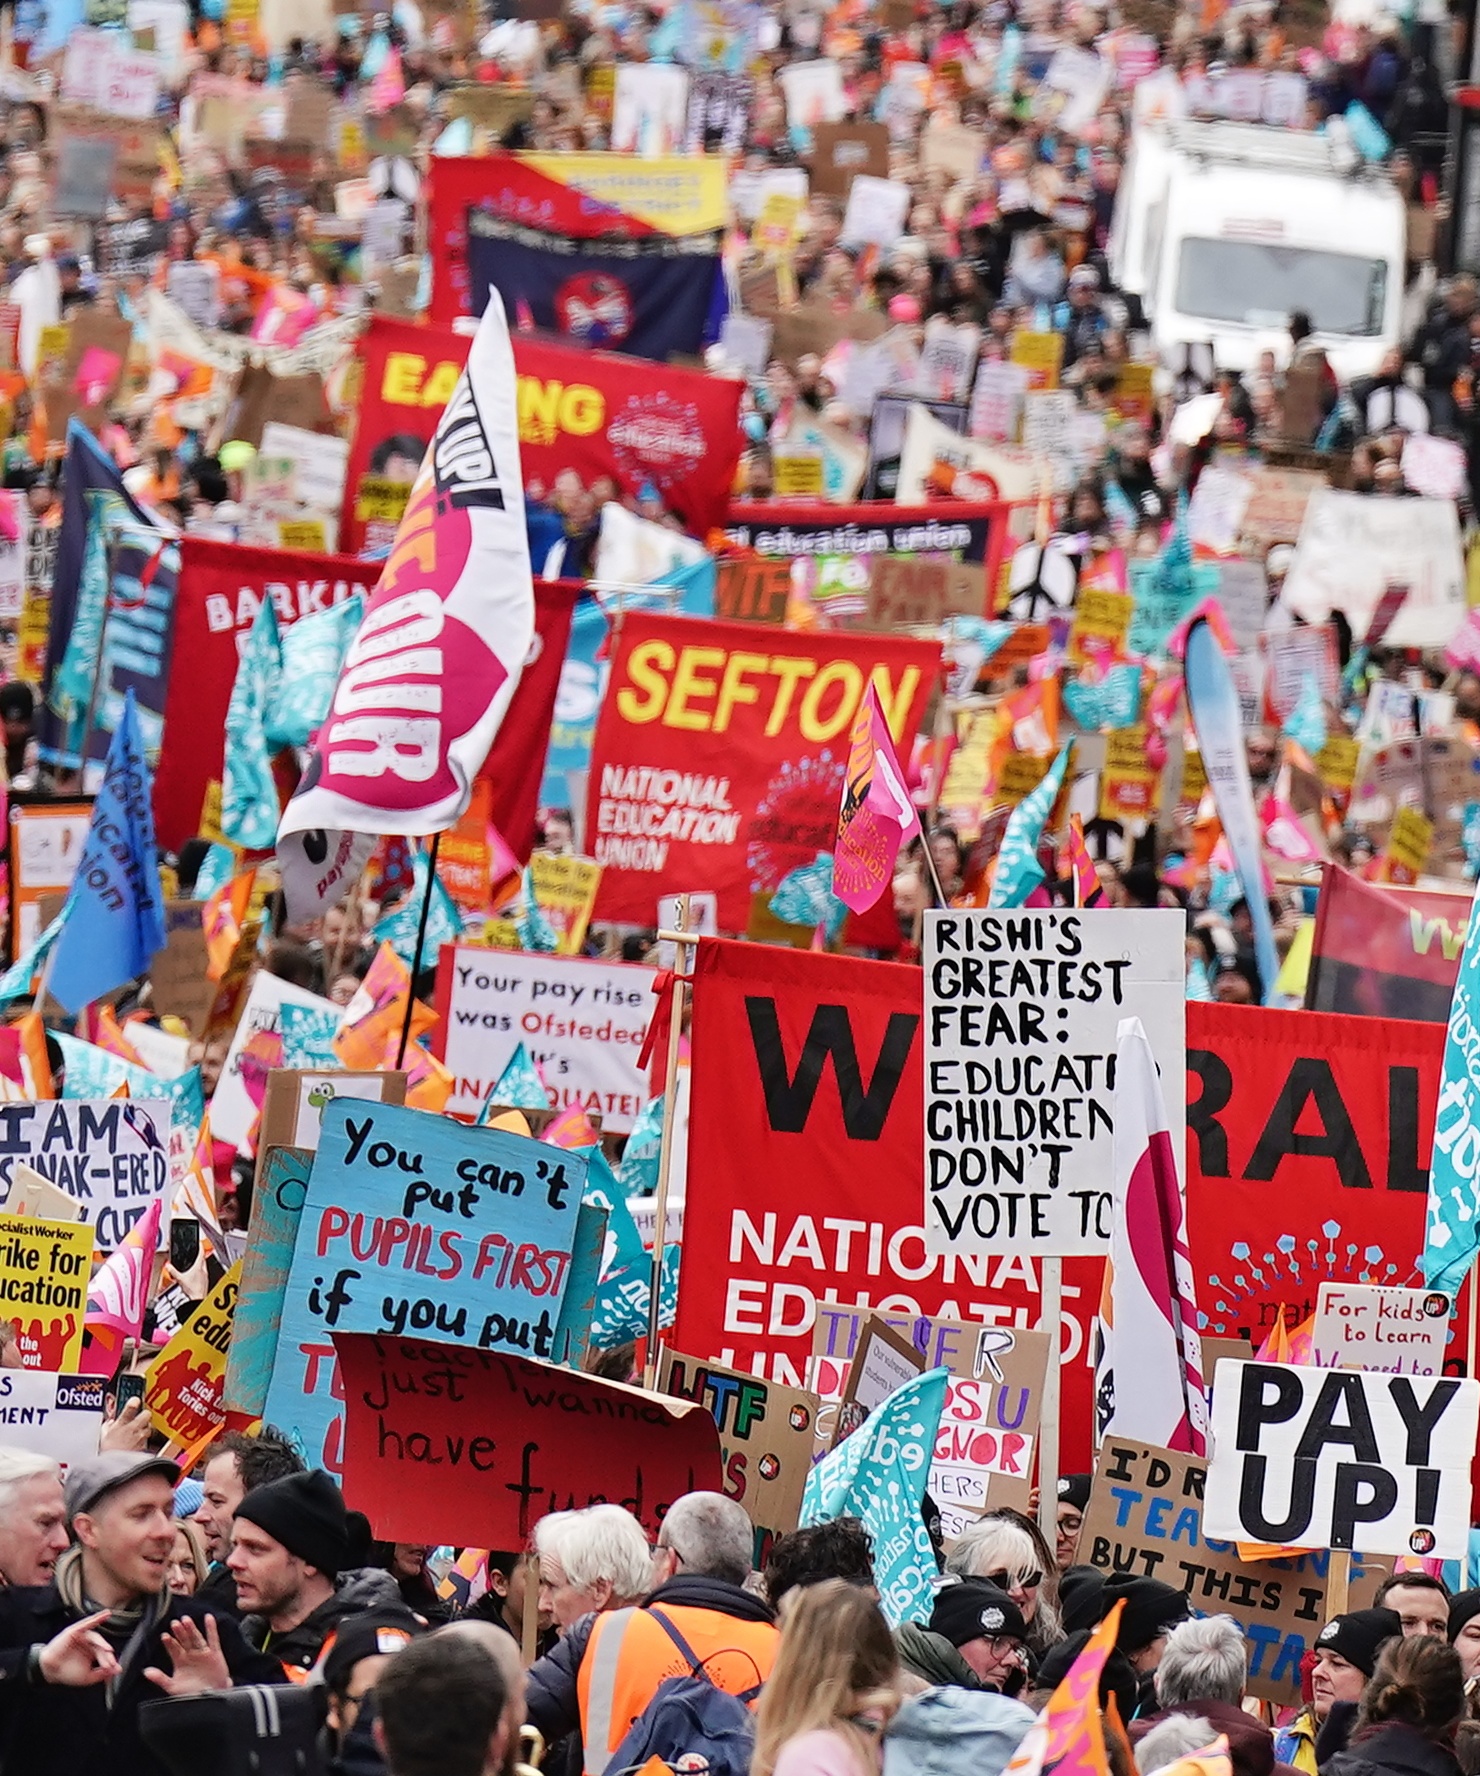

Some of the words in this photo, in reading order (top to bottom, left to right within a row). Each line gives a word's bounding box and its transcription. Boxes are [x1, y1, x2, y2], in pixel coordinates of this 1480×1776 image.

[381, 351, 605, 436] EAING
[205, 580, 378, 633] BARKIN
[328, 588, 444, 783] OUR
[617, 639, 921, 744] SEFTON
[600, 763, 732, 811] NATIONAL
[597, 799, 742, 844] EDUCATION
[595, 837, 669, 872] UNION
[838, 823, 886, 883] ducation
[936, 916, 1082, 957] RISHI'S
[457, 966, 523, 993] Your
[532, 979, 585, 1006] pay
[593, 981, 643, 1007] rise
[932, 958, 1131, 1005] GREATEST
[456, 1009, 513, 1032] was
[521, 1012, 648, 1046] Ofsteded
[932, 1004, 1069, 1047] FEAR:
[1, 1105, 35, 1153] I
[42, 1104, 120, 1154] AM
[928, 1097, 1115, 1142] CHILDREN
[344, 1117, 424, 1174] You
[456, 1158, 569, 1210] can't
[930, 1144, 1072, 1191] DON'T
[403, 1180, 480, 1218] put
[932, 1194, 1052, 1241] VOTE
[0, 1223, 36, 1237] ocialist
[35, 1226, 75, 1241] Worker
[95, 1205, 163, 1250] CUT
[0, 1238, 40, 1270] rike
[49, 1243, 86, 1277] for
[316, 1206, 463, 1280] PUPILS
[472, 1233, 573, 1297] FIRST
[0, 1276, 81, 1309] ucation
[308, 1269, 362, 1326] if
[382, 1296, 467, 1336] you
[480, 1309, 555, 1358] put
[1324, 1292, 1368, 1317] For
[1378, 1296, 1425, 1321] kids
[20, 1335, 39, 1352] the
[1344, 1323, 1366, 1342] to
[1376, 1321, 1432, 1344] learn
[190, 1378, 216, 1403] Kick
[1412, 1359, 1433, 1376] to
[57, 1386, 103, 1408] Ofsted
[176, 1386, 208, 1418] Tories
[363, 1368, 472, 1410] just
[523, 1385, 672, 1427] wanna
[668, 1360, 768, 1441] WTF
[1235, 1363, 1462, 1467] PAY
[378, 1414, 496, 1471] have
[934, 1425, 1025, 1474] GNOR
[1105, 1446, 1171, 1489] I'D
[1238, 1453, 1442, 1549] UP!
[1089, 1536, 1165, 1575] BUT
[1179, 1560, 1283, 1612] THIS
